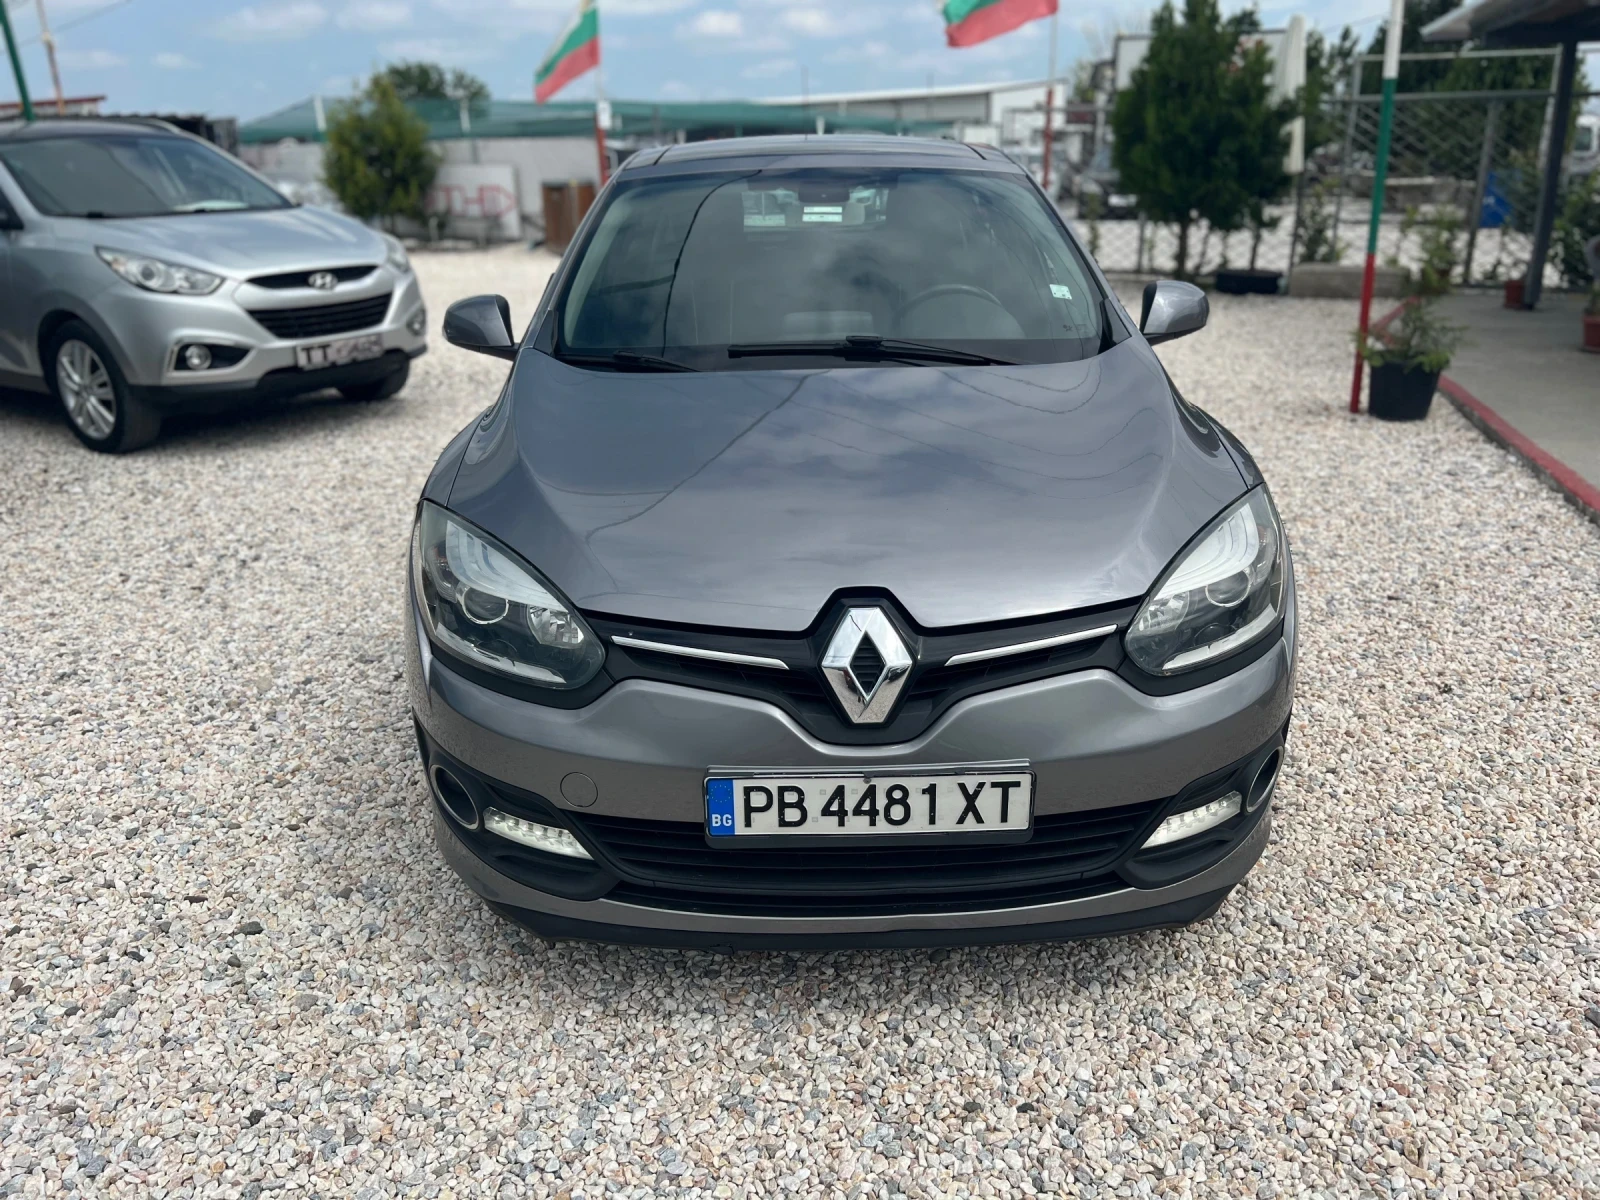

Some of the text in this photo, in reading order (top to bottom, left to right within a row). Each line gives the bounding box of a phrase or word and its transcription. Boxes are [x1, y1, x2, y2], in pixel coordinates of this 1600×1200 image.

[743, 780, 1022, 828] PB 4481 XT
[711, 813, 733, 827] BG
